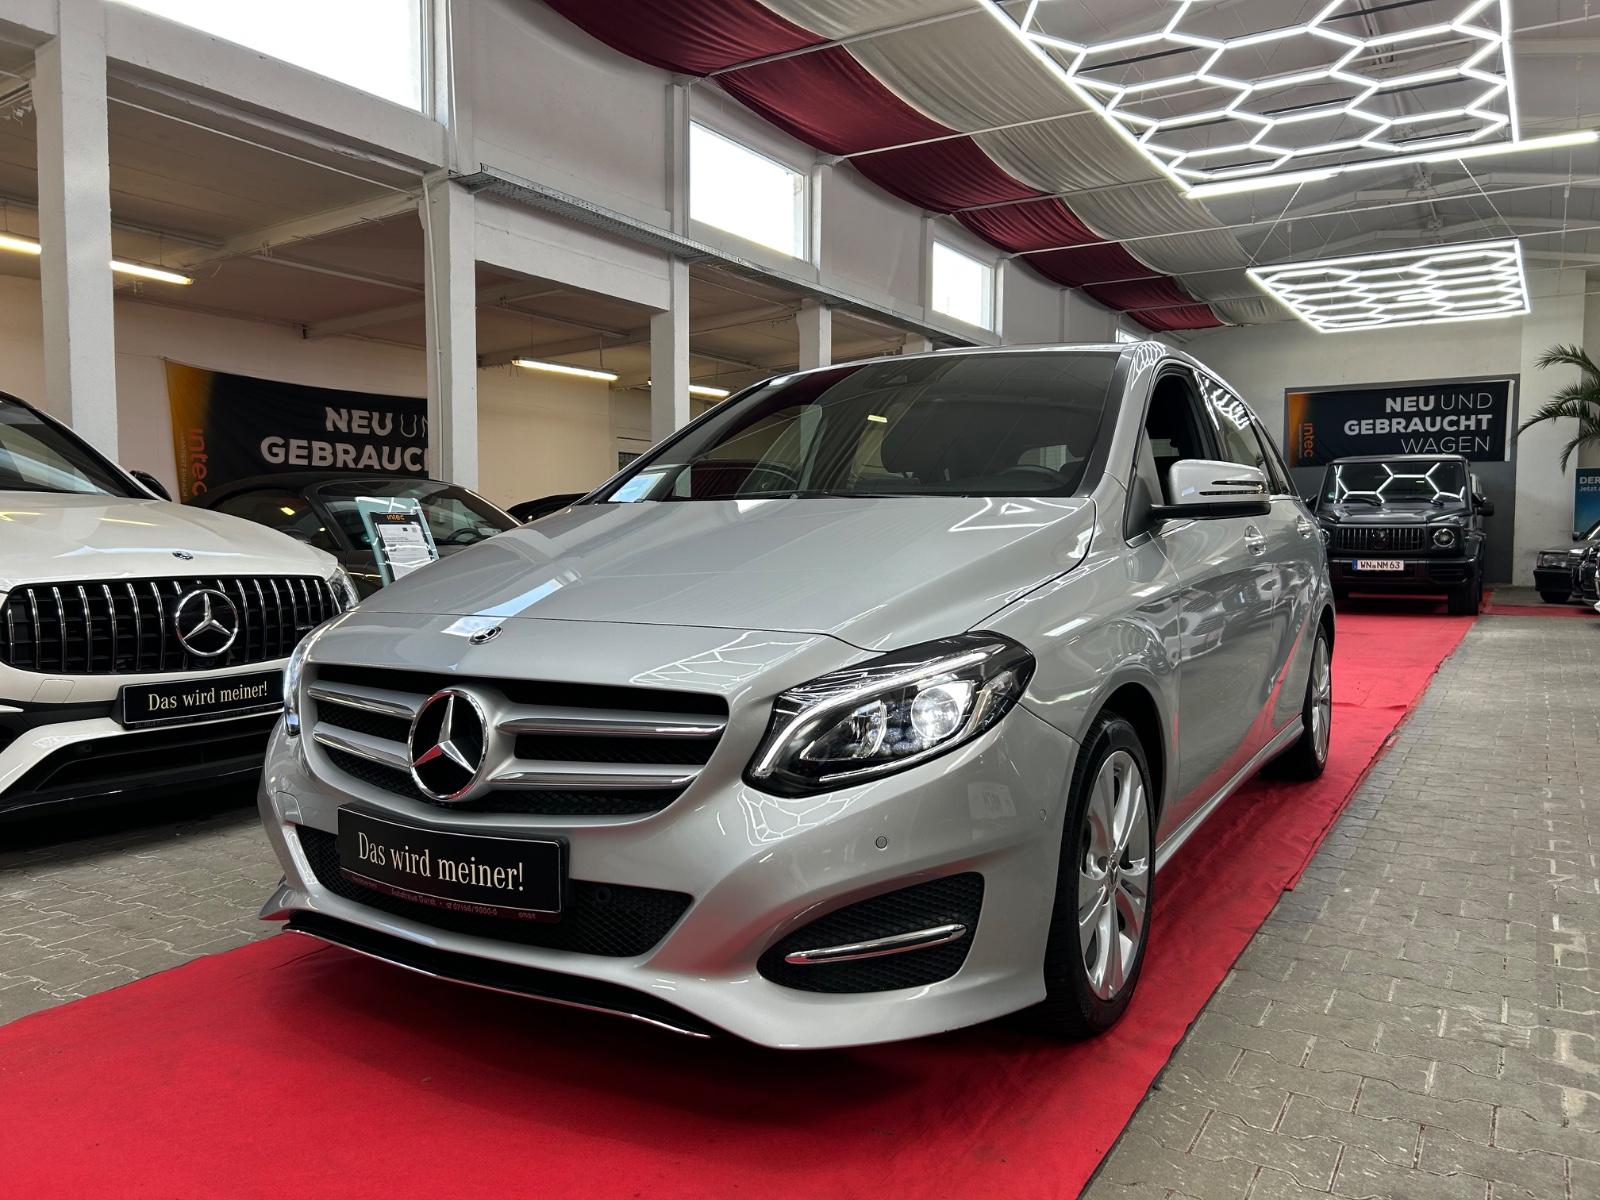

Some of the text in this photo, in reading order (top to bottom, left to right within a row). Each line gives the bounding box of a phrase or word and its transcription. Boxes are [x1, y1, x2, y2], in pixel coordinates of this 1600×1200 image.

[1385, 392, 1493, 413] NEU UND
[325, 406, 393, 436] NEU
[1344, 414, 1493, 436] GEBRAUCHT
[260, 436, 428, 472] GEBRAUC
[1303, 423, 1314, 457] intec
[1401, 435, 1490, 454] WAGEN
[192, 428, 208, 497] intec
[1360, 561, 1372, 569] WN
[148, 681, 267, 711] Das wird meiner!
[358, 831, 524, 892] Das wird meiner!
